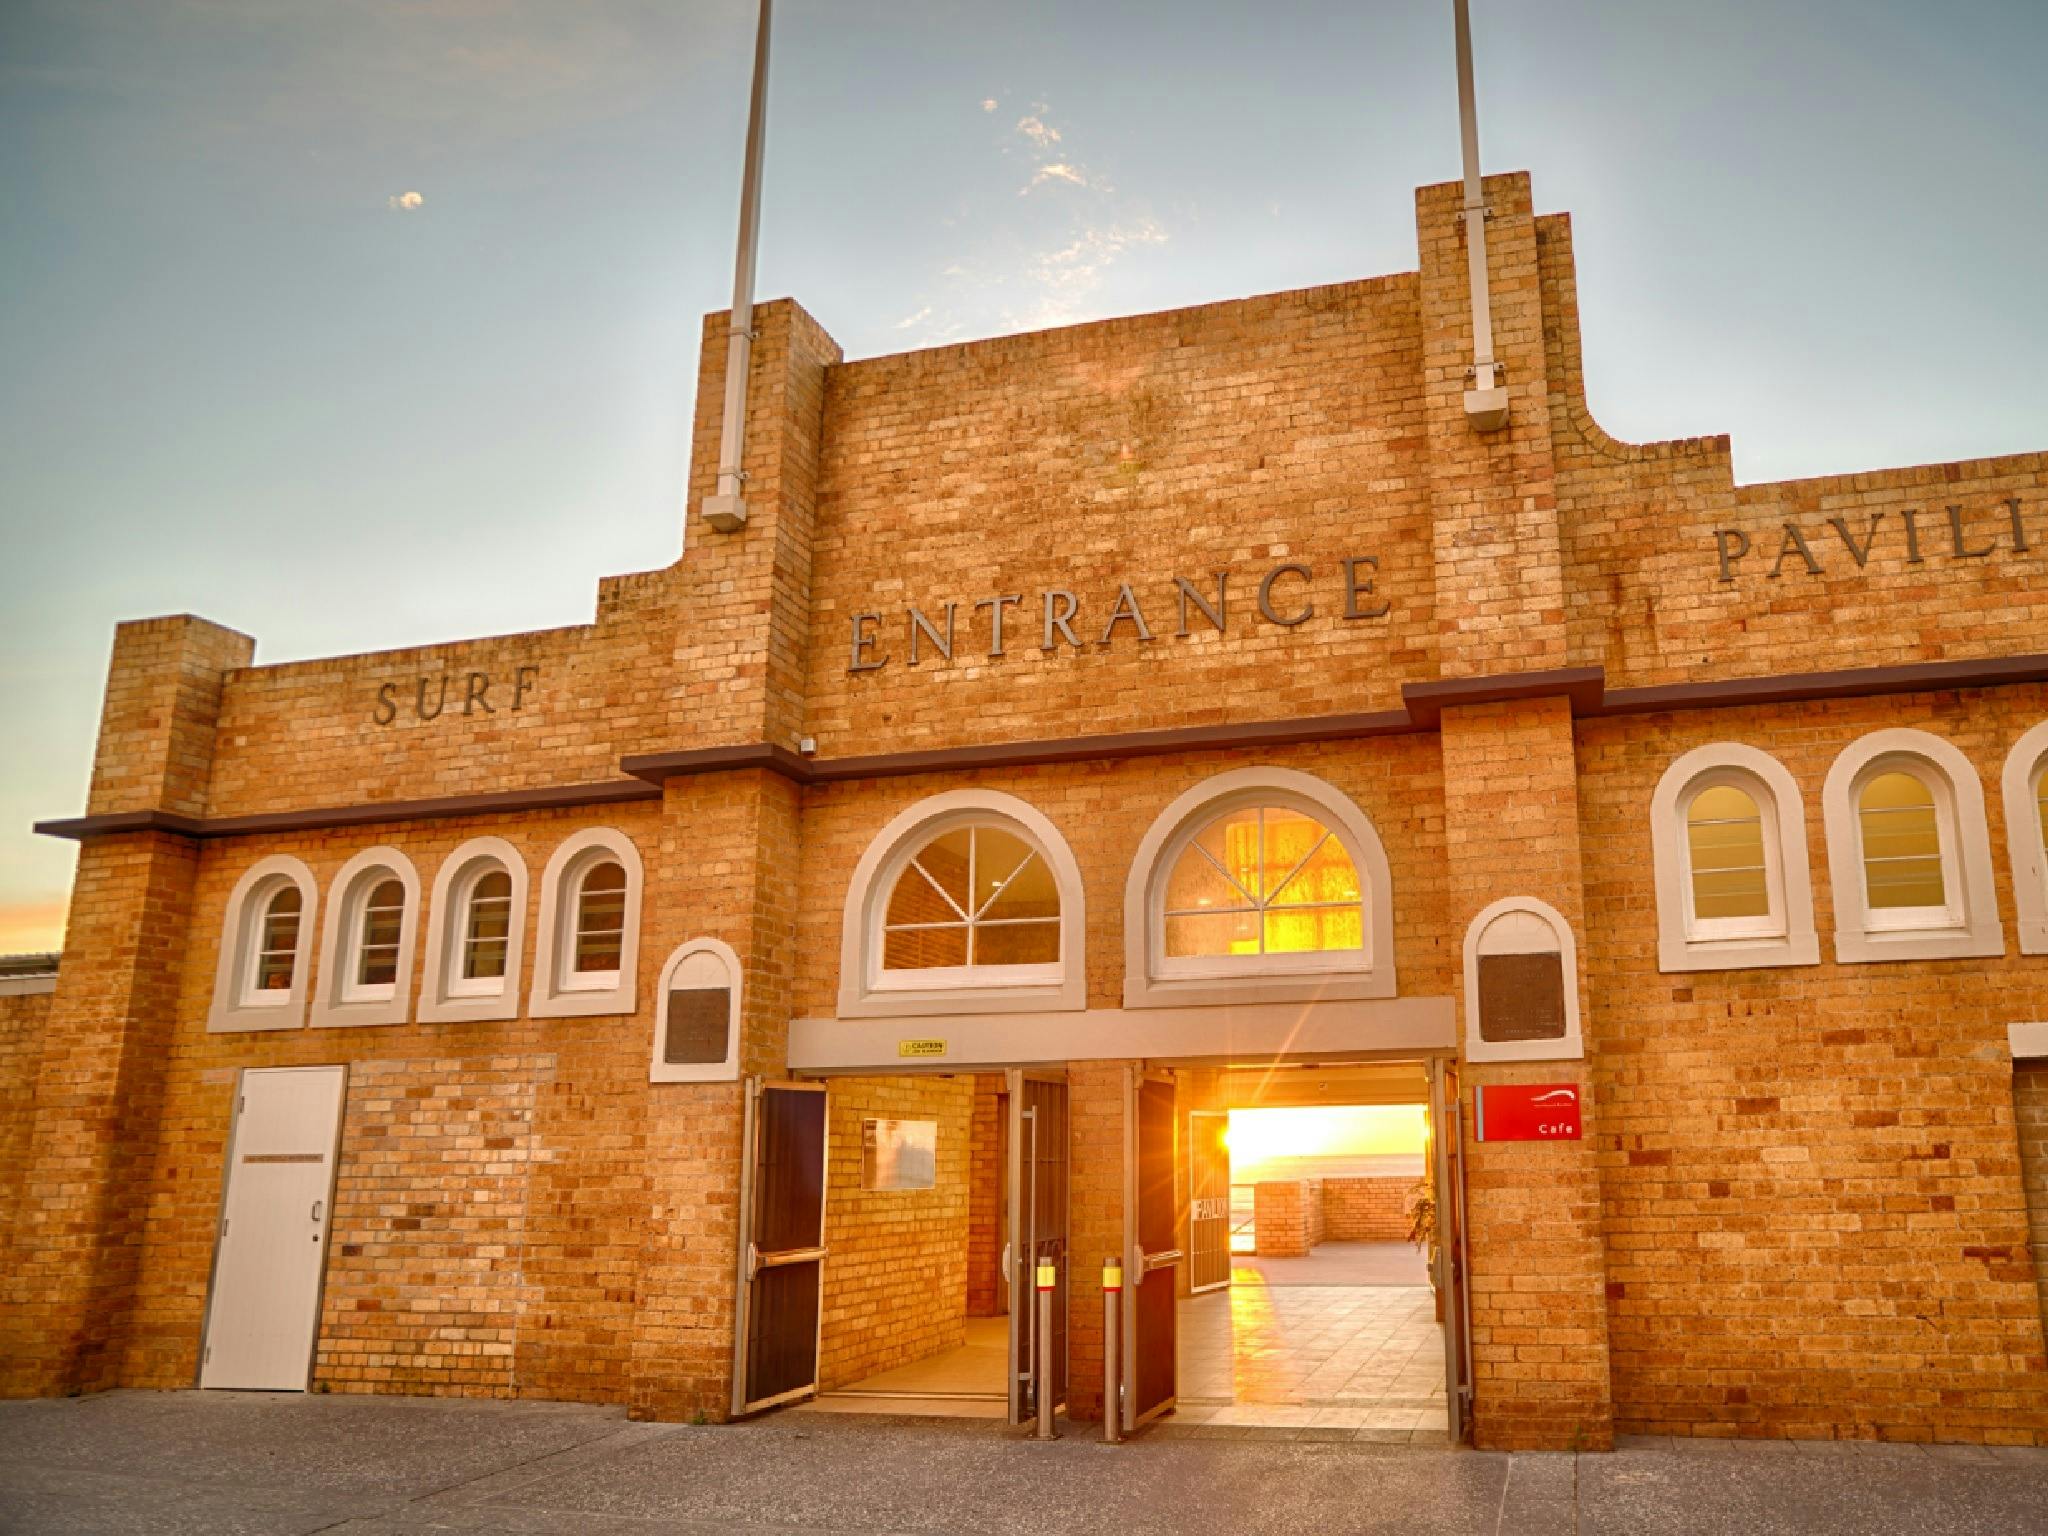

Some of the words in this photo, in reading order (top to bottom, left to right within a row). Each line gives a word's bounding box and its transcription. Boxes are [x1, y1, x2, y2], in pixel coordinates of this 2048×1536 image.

[1713, 498, 2030, 582] PAVILI
[848, 555, 1392, 672] ENTRANCE
[373, 664, 539, 726] SURF
[1538, 1122, 1573, 1134] Cafe
